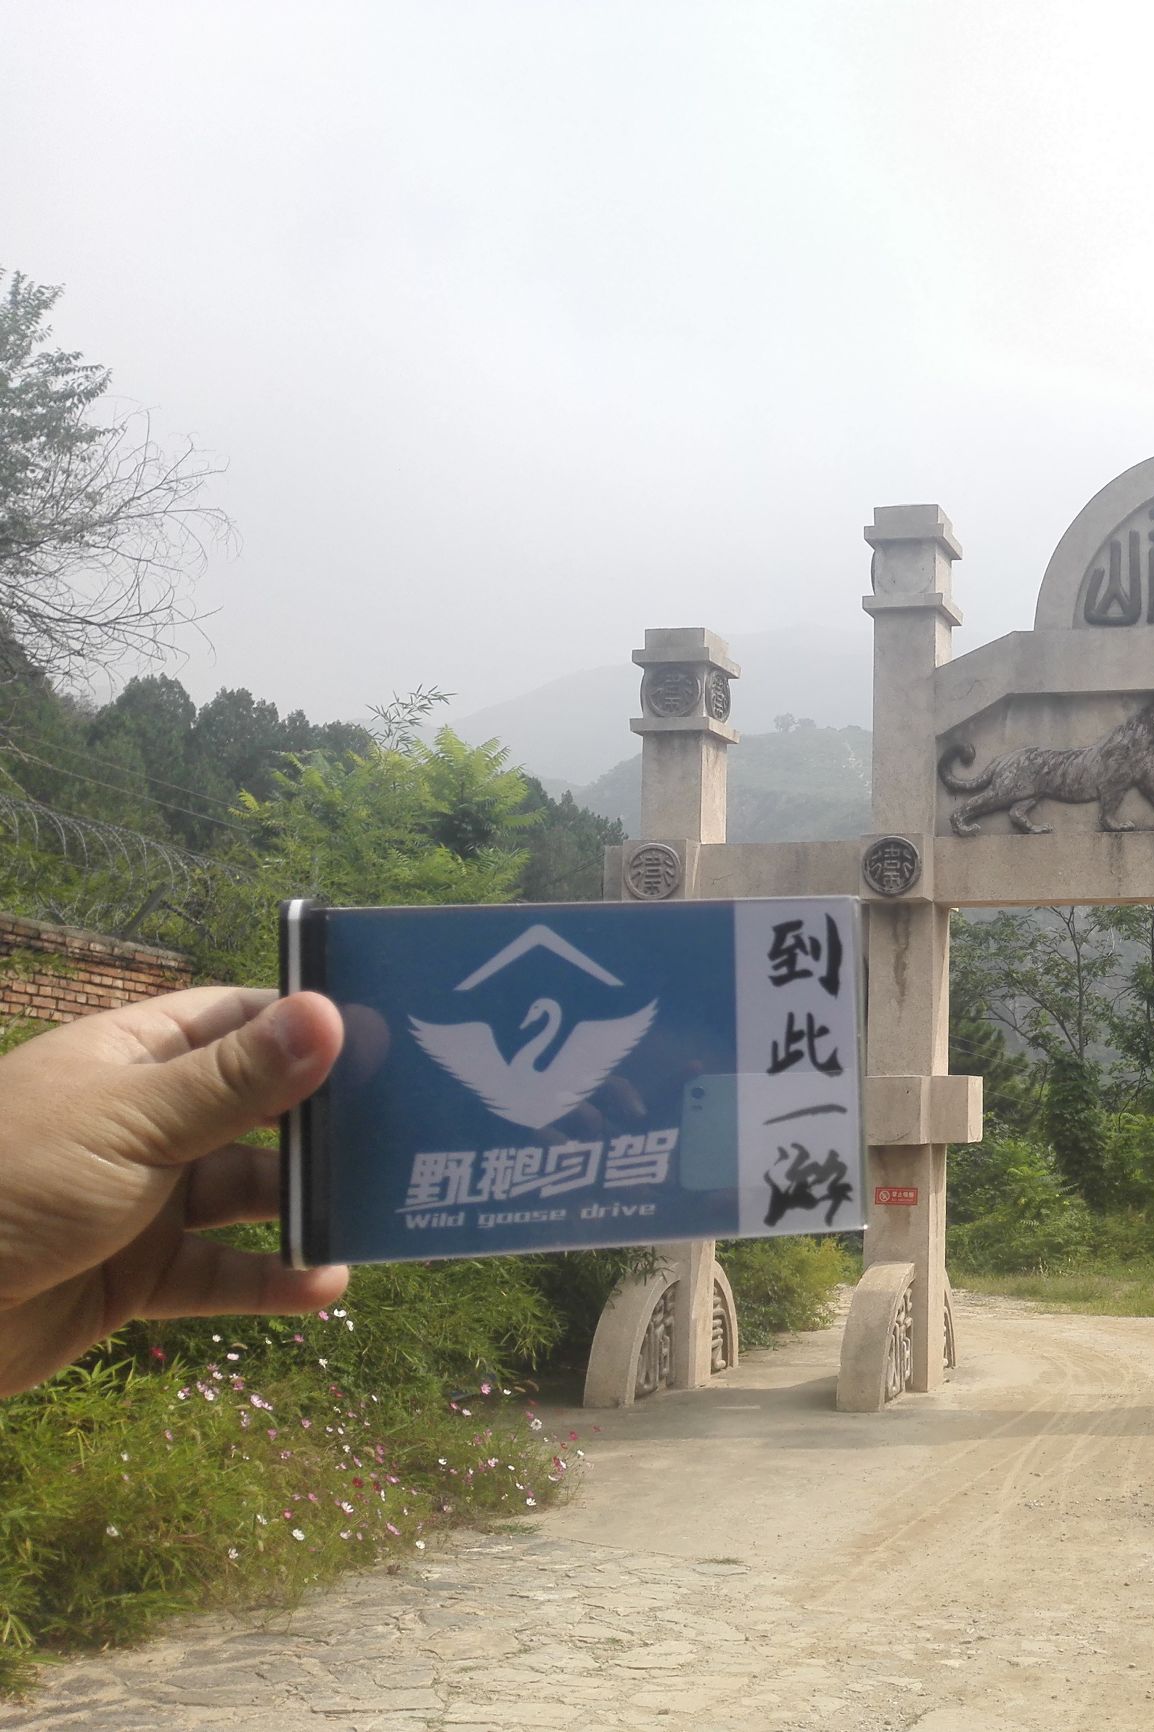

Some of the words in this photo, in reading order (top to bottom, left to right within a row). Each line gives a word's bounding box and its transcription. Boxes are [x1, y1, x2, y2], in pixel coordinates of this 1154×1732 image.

[763, 912, 853, 1227] 到此一游
[396, 1128, 679, 1212] 野鹅自驾
[405, 1211, 465, 1229] Wild
[477, 1209, 567, 1228] goose
[580, 1203, 656, 1219] drive
